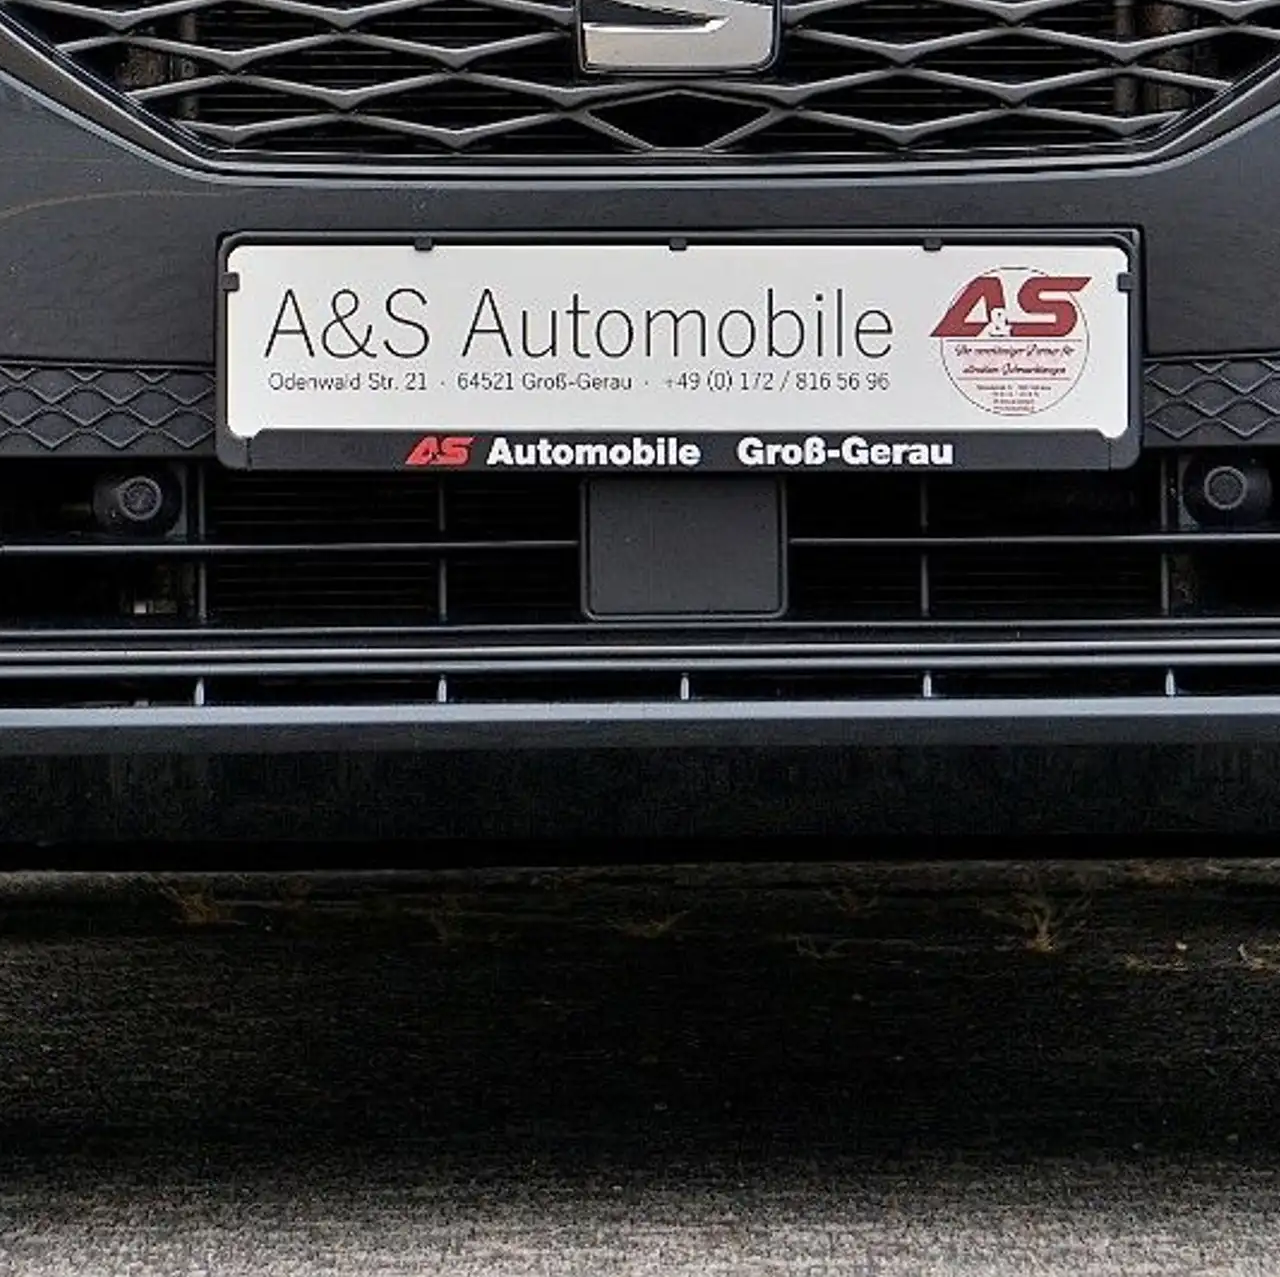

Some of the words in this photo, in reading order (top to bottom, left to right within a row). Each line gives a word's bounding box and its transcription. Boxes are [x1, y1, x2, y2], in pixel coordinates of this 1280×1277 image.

[263, 288, 431, 360] A&S
[460, 287, 894, 360] Automobile
[267, 371, 362, 392] Odenwald
[368, 371, 400, 392] Str.
[405, 371, 428, 392] 21
[456, 371, 515, 392] 64521
[521, 371, 633, 392] Groß-Gerau
[664, 371, 702, 392] +49
[706, 370, 733, 393] (0)
[740, 371, 775, 392] 172
[795, 371, 832, 392] 816
[836, 371, 861, 392] 56
[865, 371, 891, 392] 96
[485, 437, 702, 467] Automobile
[736, 435, 955, 467] Groß-Gerau
